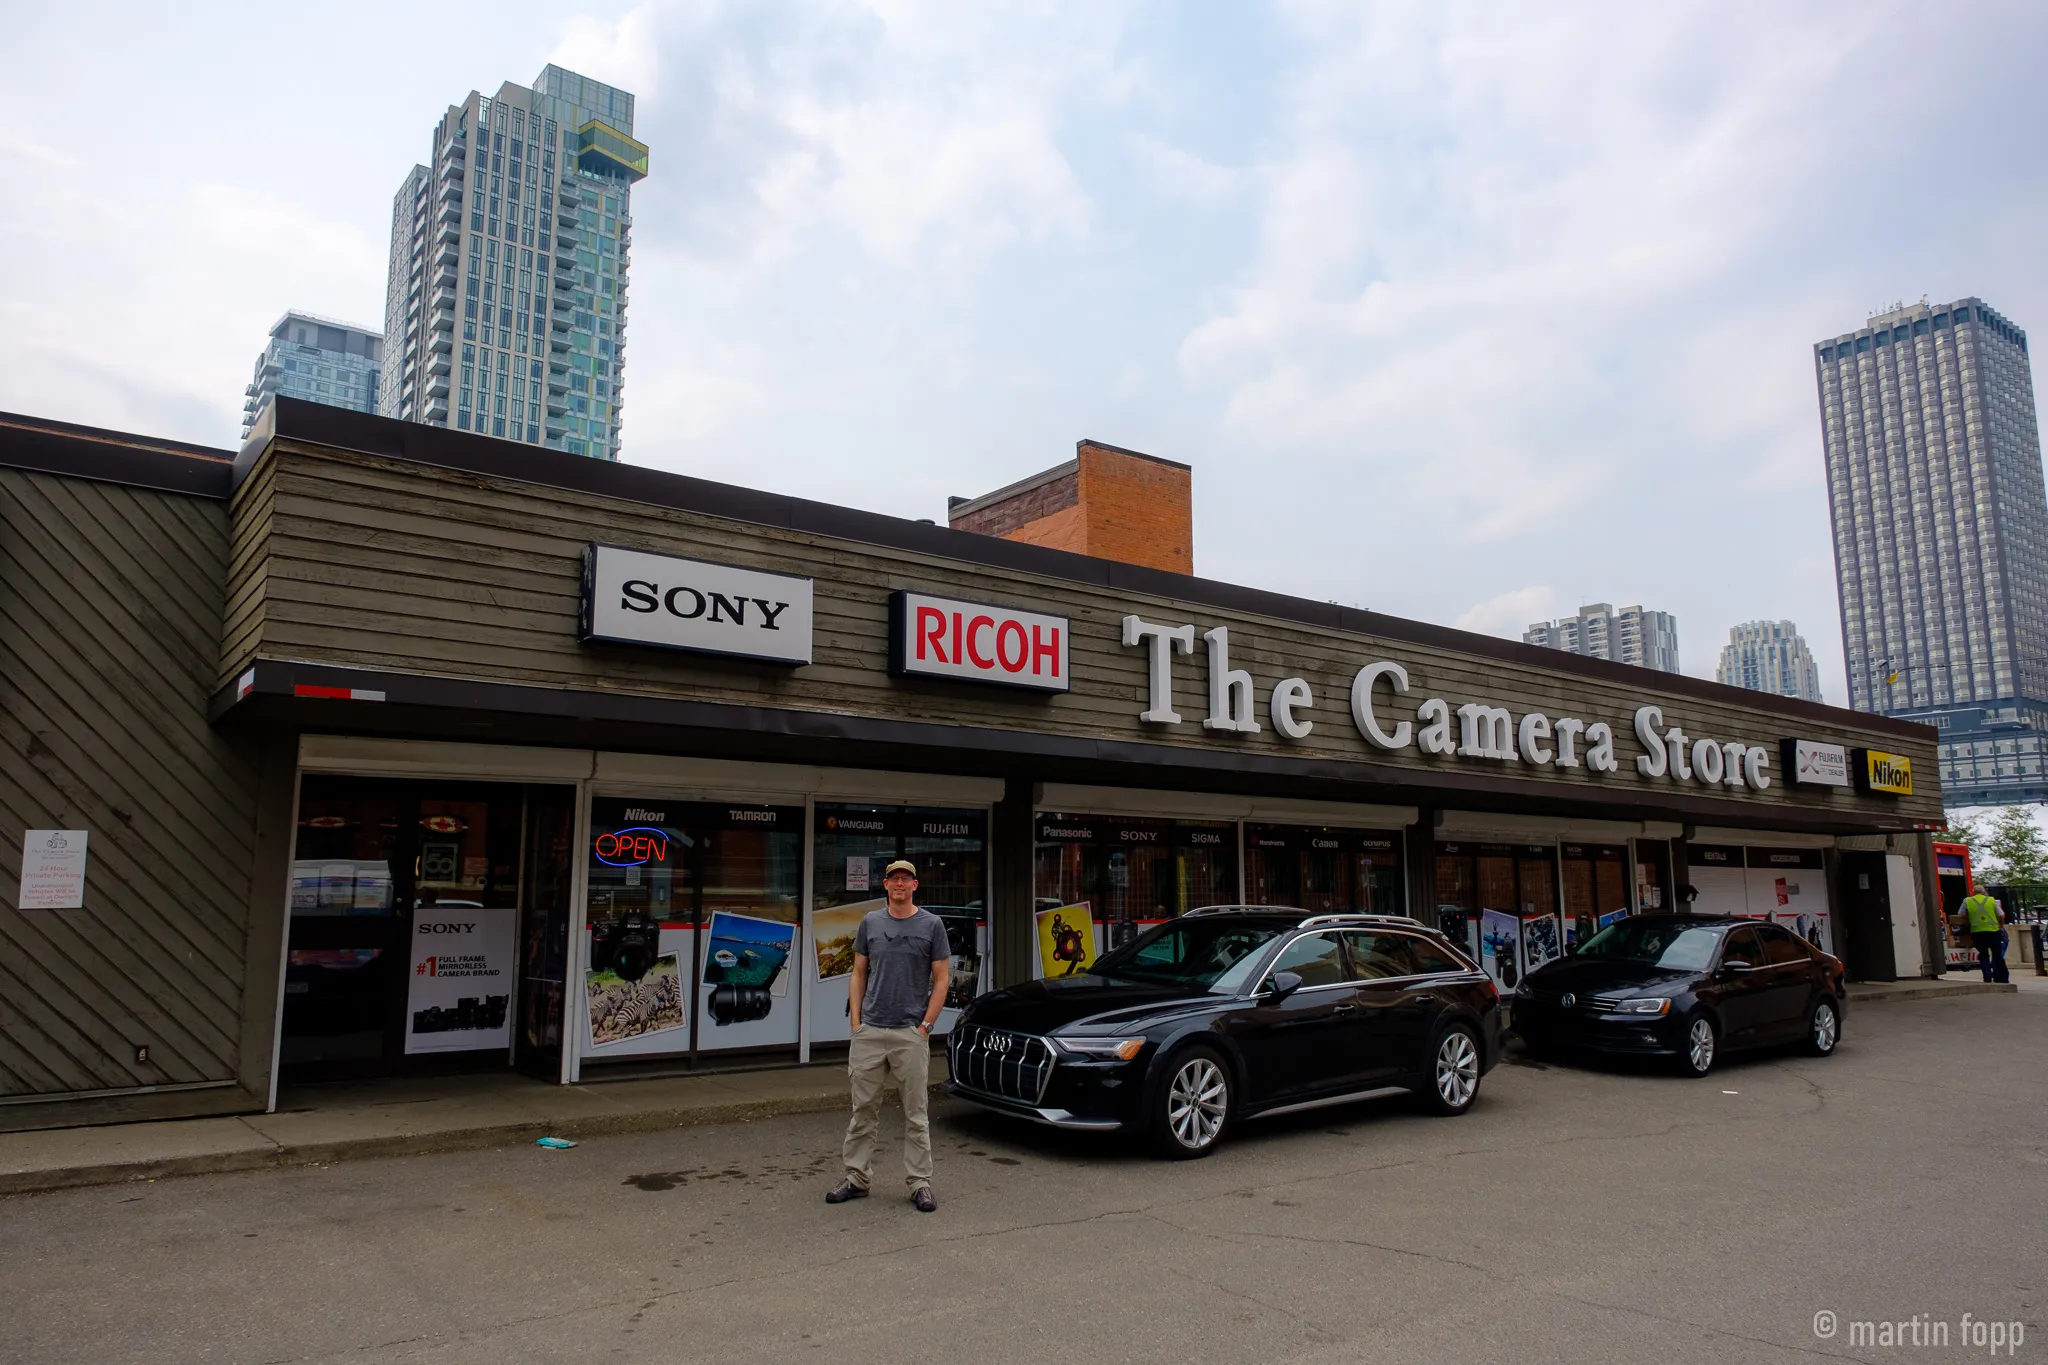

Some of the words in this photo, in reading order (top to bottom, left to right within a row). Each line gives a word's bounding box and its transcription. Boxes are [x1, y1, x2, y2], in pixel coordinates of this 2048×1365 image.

[621, 580, 790, 631] SONY
[916, 606, 1060, 678] RICOH
[1122, 615, 1313, 739] The
[1351, 661, 1618, 774] Camera
[1635, 706, 1771, 789] Store
[1873, 760, 1910, 788] Nikon
[624, 808, 666, 822] Nikon
[729, 810, 777, 822] TAMRON
[838, 819, 884, 831] VANGUARD
[1043, 825, 1092, 839] Panasonic
[1120, 831, 1158, 841] SONY
[1191, 833, 1221, 844] SIGMA
[1311, 838, 1339, 849] Canon
[1363, 840, 1391, 848] OLYMPUS
[596, 833, 667, 862] OPEN
[1704, 851, 1727, 861] RENTALS
[54, 872, 81, 880] Parking
[419, 923, 477, 934] SONY
[416, 956, 437, 977] #1
[438, 962, 487, 970] MIRRORLESS
[473, 969, 500, 977] BRAND
